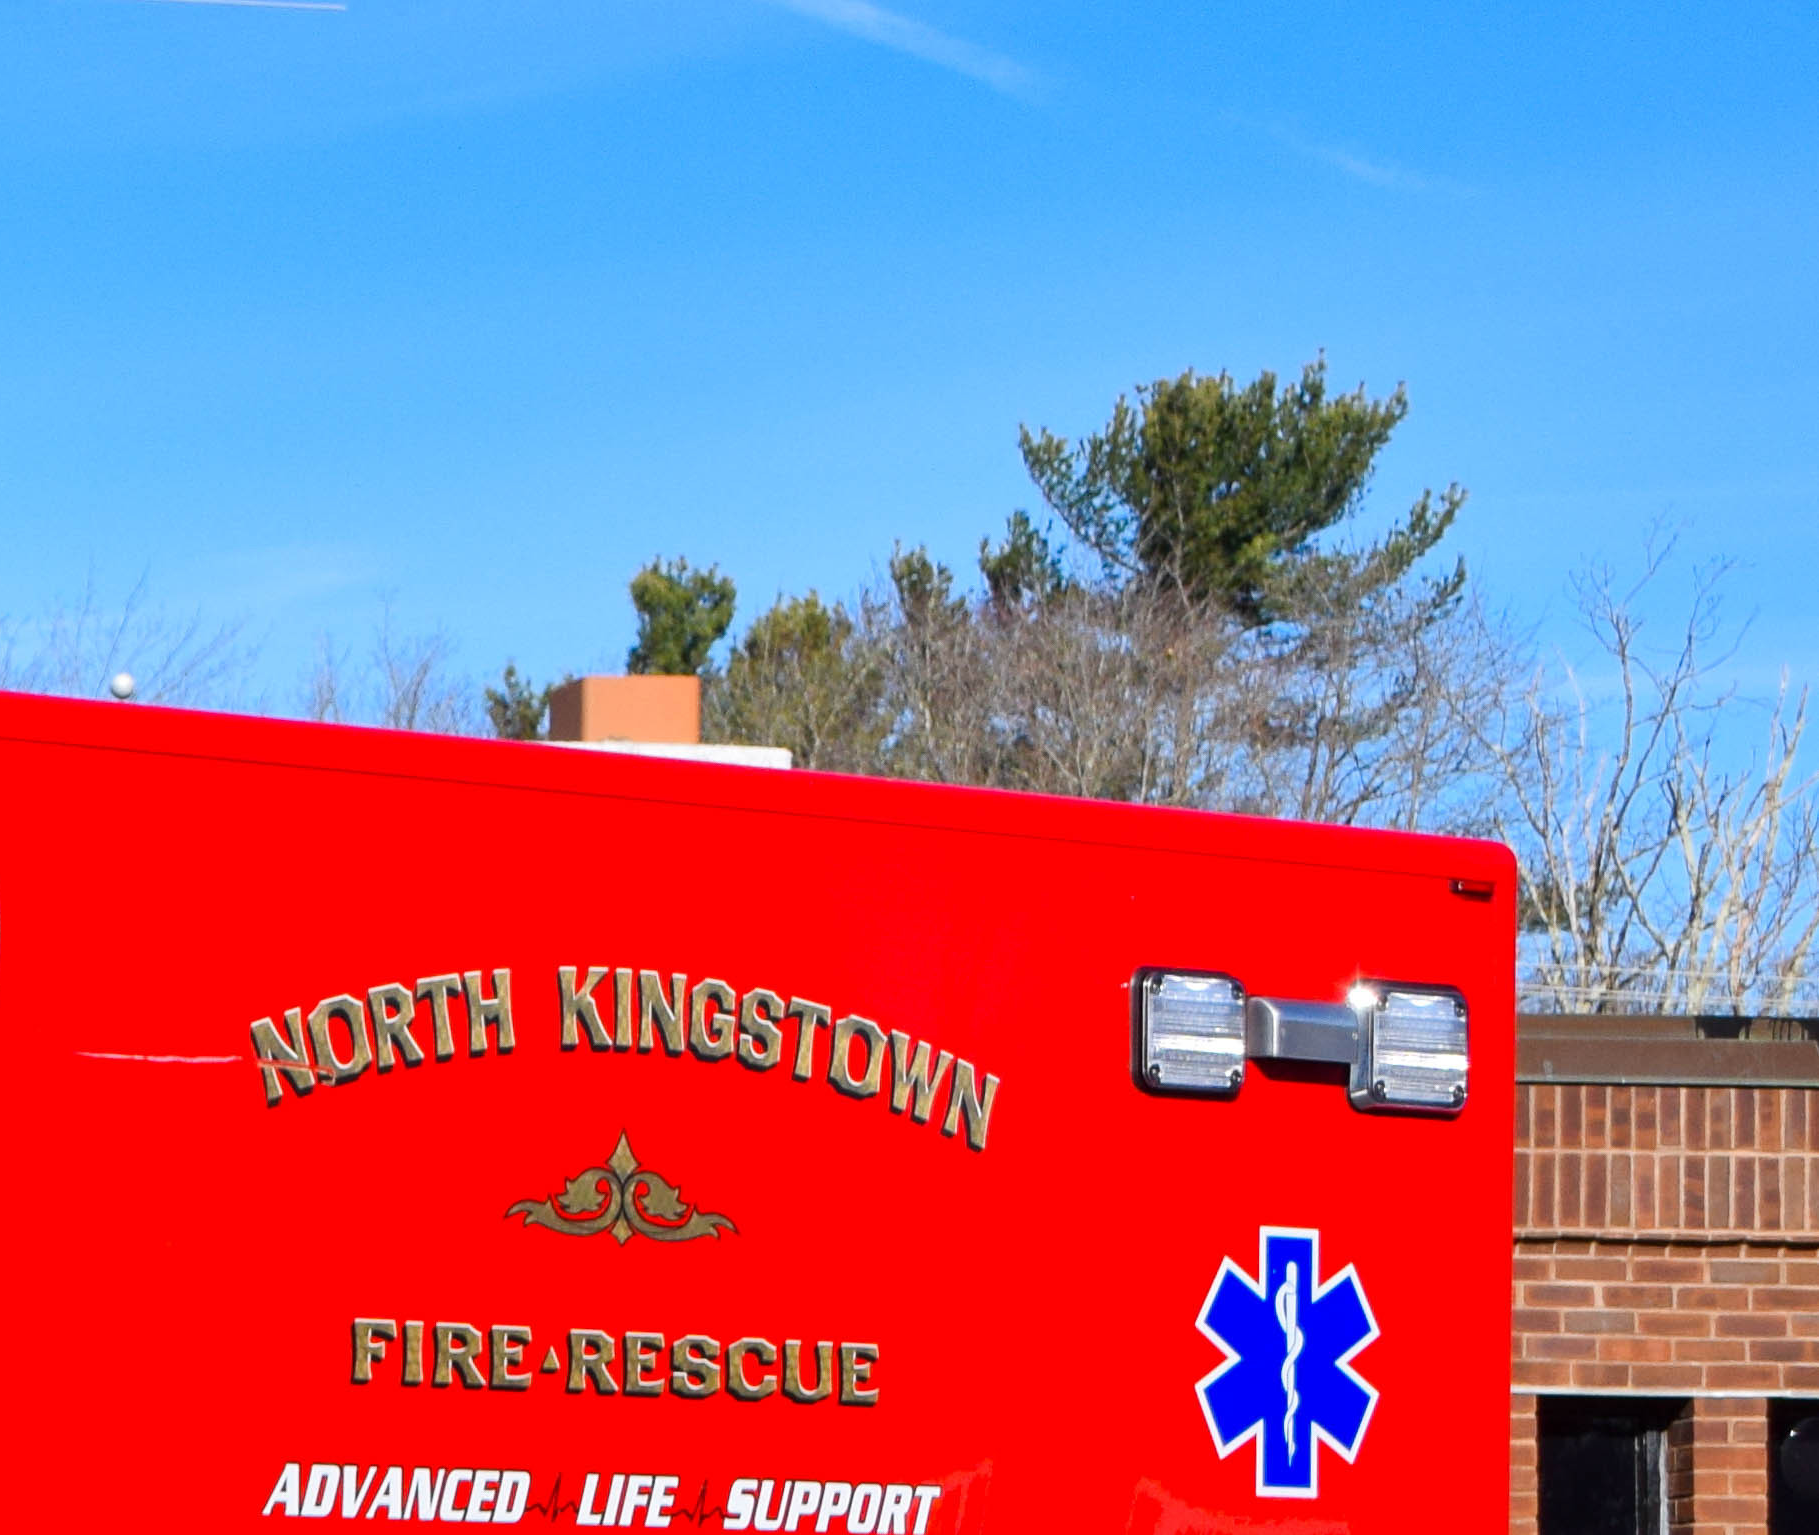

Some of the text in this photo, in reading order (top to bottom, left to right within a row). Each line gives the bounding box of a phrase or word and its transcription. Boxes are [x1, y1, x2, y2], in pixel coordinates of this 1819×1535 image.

[250, 965, 1001, 1152] NORTH KINGSTOWN
[351, 1318, 880, 1406] FIRE RESCUE
[262, 1462, 530, 1524] ADVANCED
[576, 1473, 680, 1528] LIFE
